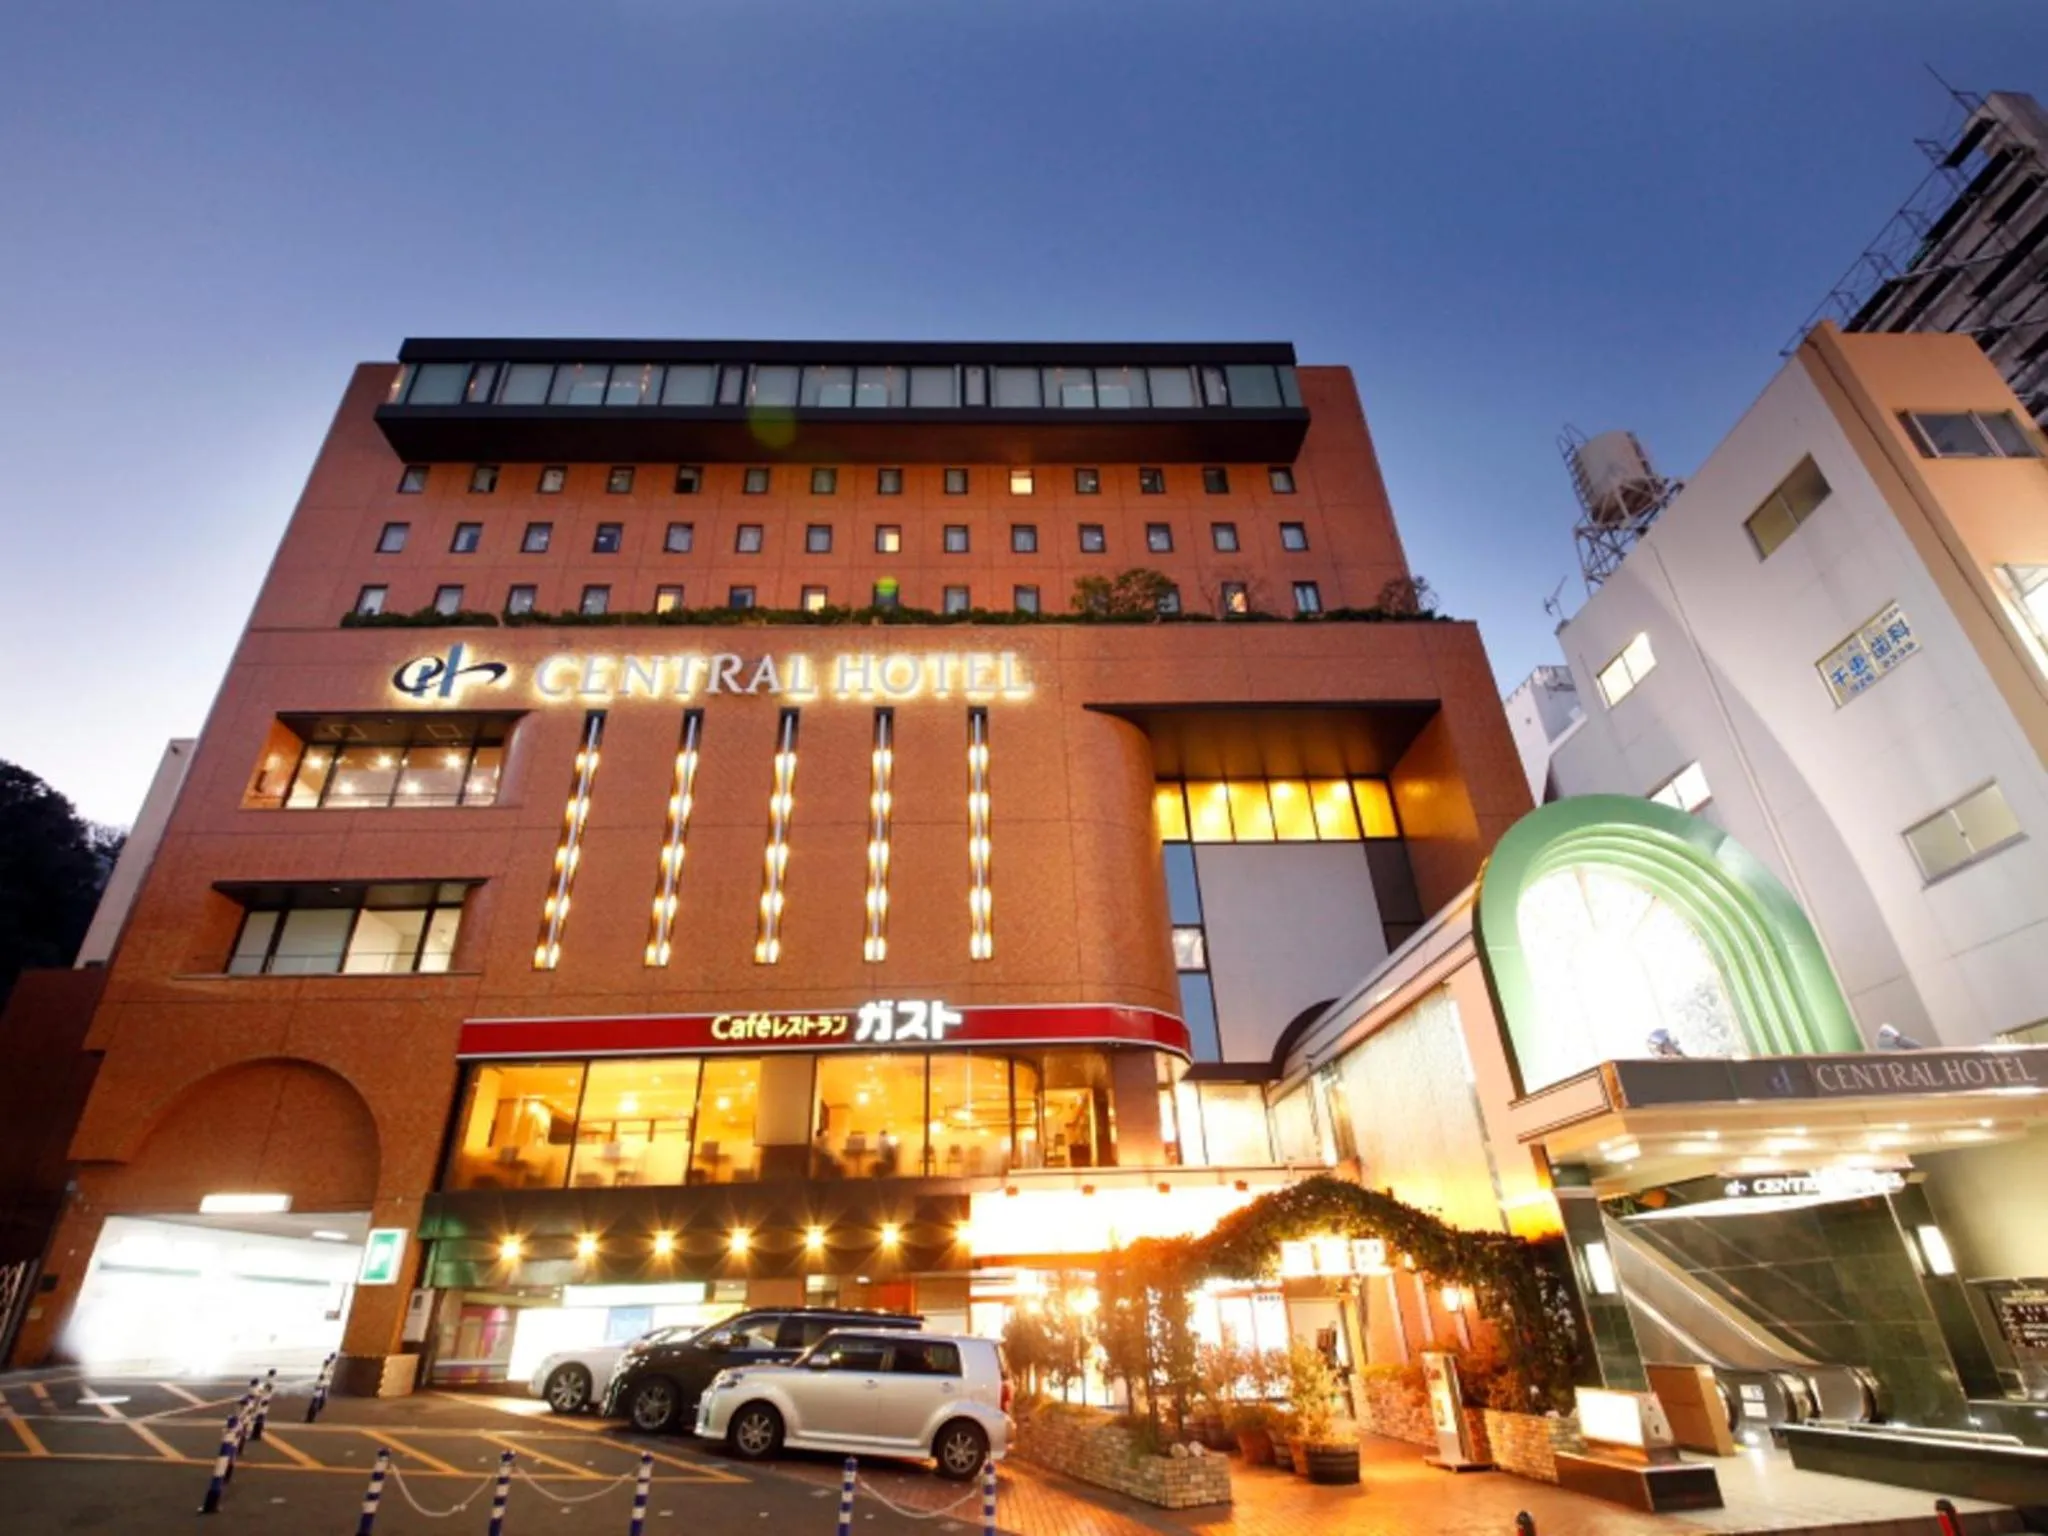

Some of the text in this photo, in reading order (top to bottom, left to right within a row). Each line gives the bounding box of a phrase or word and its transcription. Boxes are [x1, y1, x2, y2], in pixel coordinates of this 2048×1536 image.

[534, 653, 818, 698] CENTRAL
[834, 652, 1034, 697] HOTEL
[854, 999, 963, 1042] ガスト
[1816, 1061, 1944, 1092] CENTRAL
[1942, 1056, 2038, 1085] HOTEL
